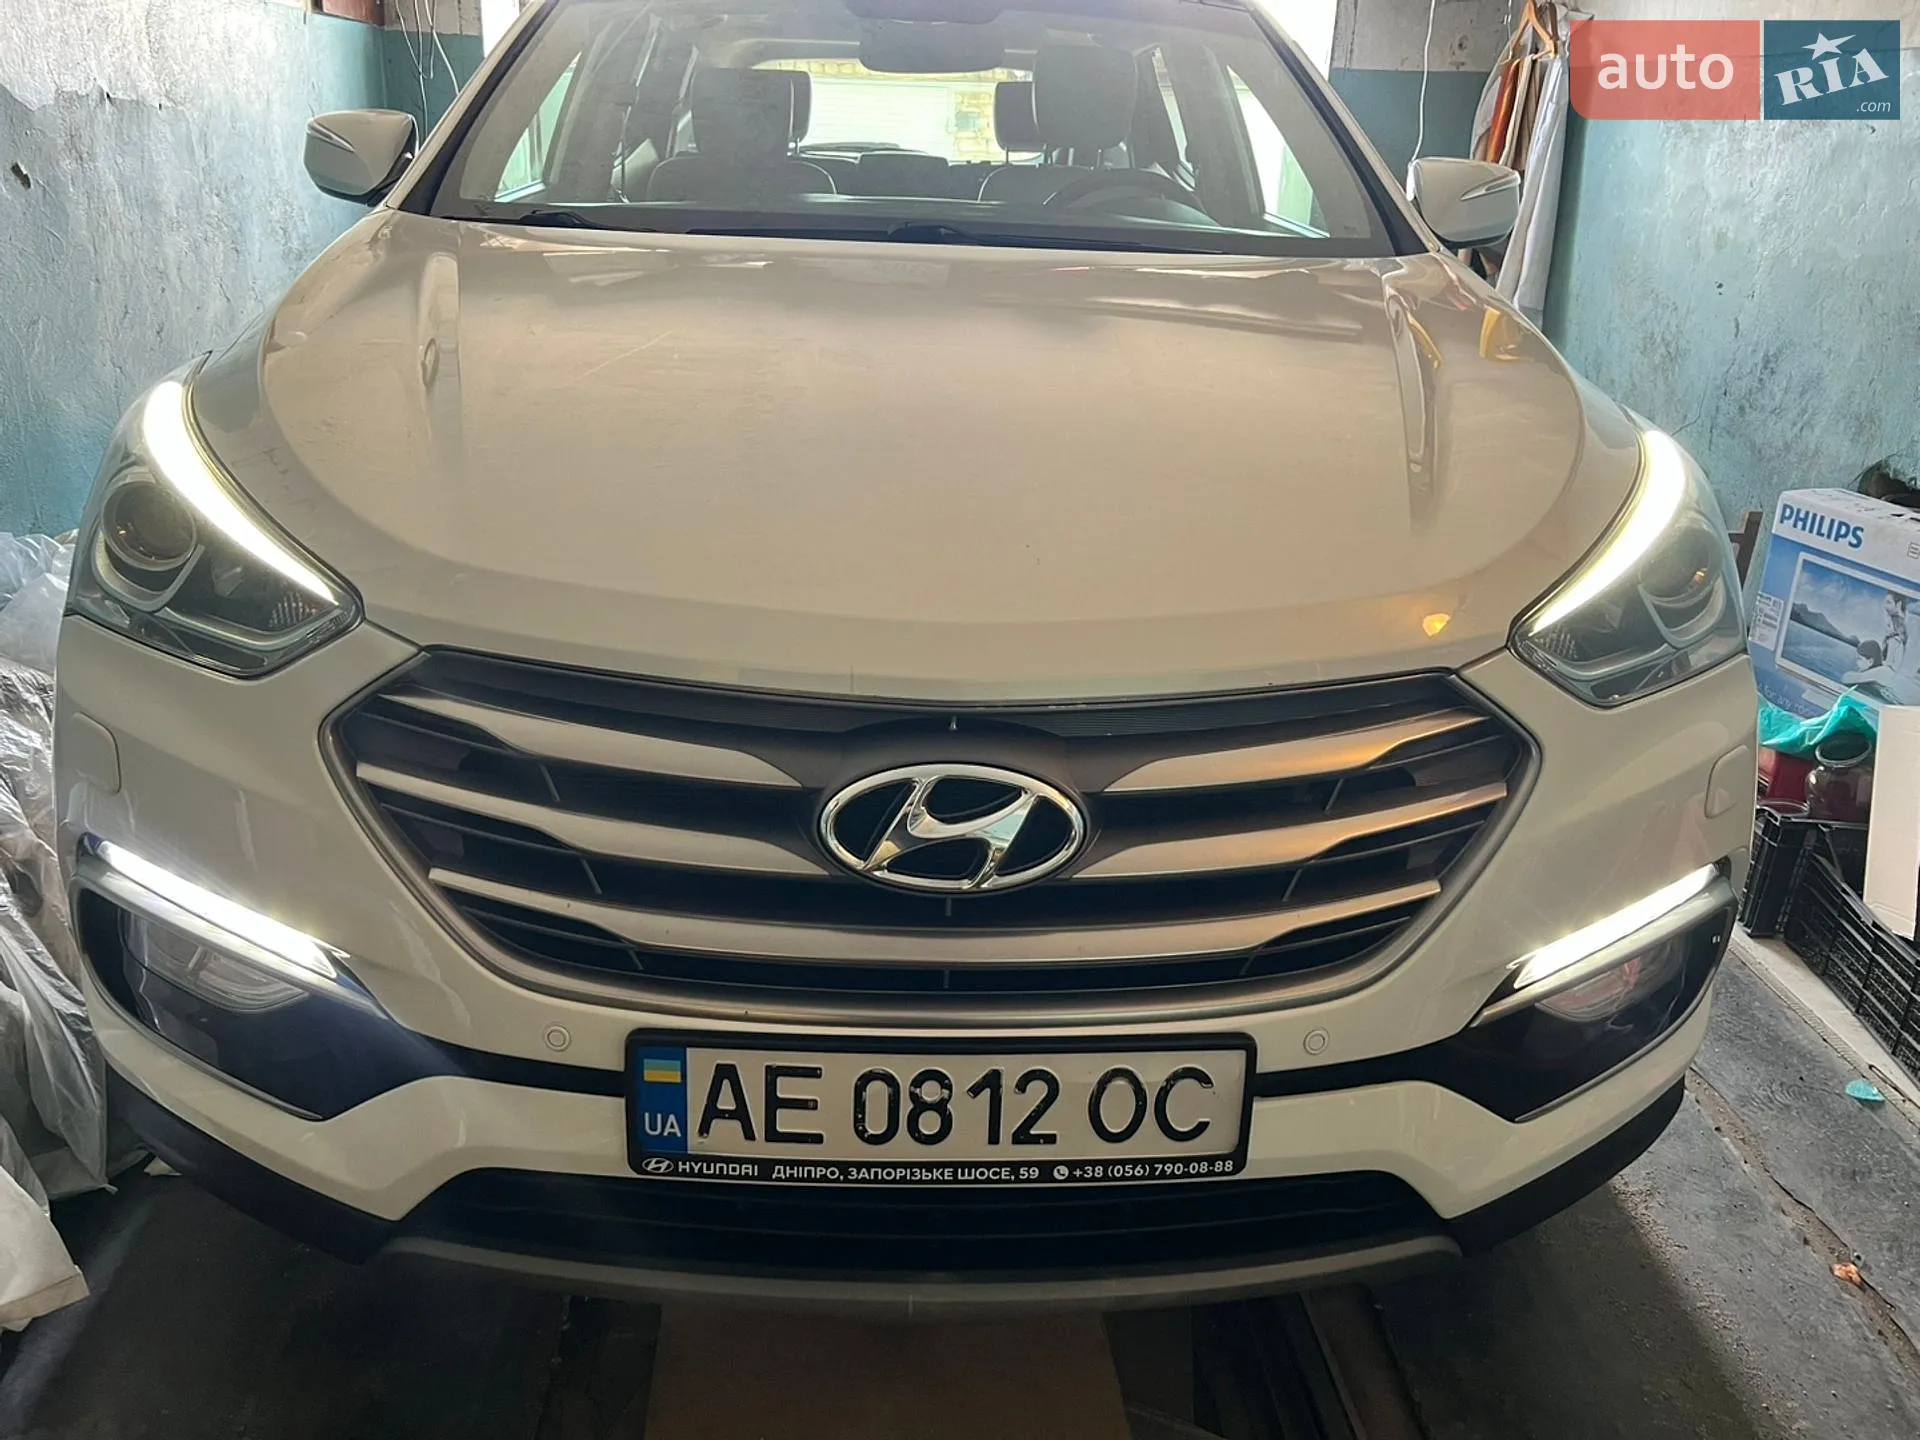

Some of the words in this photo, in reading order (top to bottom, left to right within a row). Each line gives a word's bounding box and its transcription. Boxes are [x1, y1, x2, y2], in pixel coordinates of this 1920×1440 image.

[1779, 503, 1865, 549] PHILIPS
[697, 1062, 825, 1144] AE
[852, 1067, 1061, 1145] 0812
[1088, 1066, 1215, 1143] OC
[643, 1111, 682, 1138] UA
[678, 1161, 759, 1176] HYUNDAI
[771, 1165, 844, 1181] ДНІПРО,
[847, 1167, 954, 1181] ЗАПОРІЗЬКЕ
[957, 1167, 1015, 1181] ШОСЕ,
[1019, 1166, 1040, 1179] 59
[1072, 1165, 1103, 1178] +38
[1107, 1164, 1150, 1178] (056)
[1153, 1160, 1234, 1176] 790-08-88
